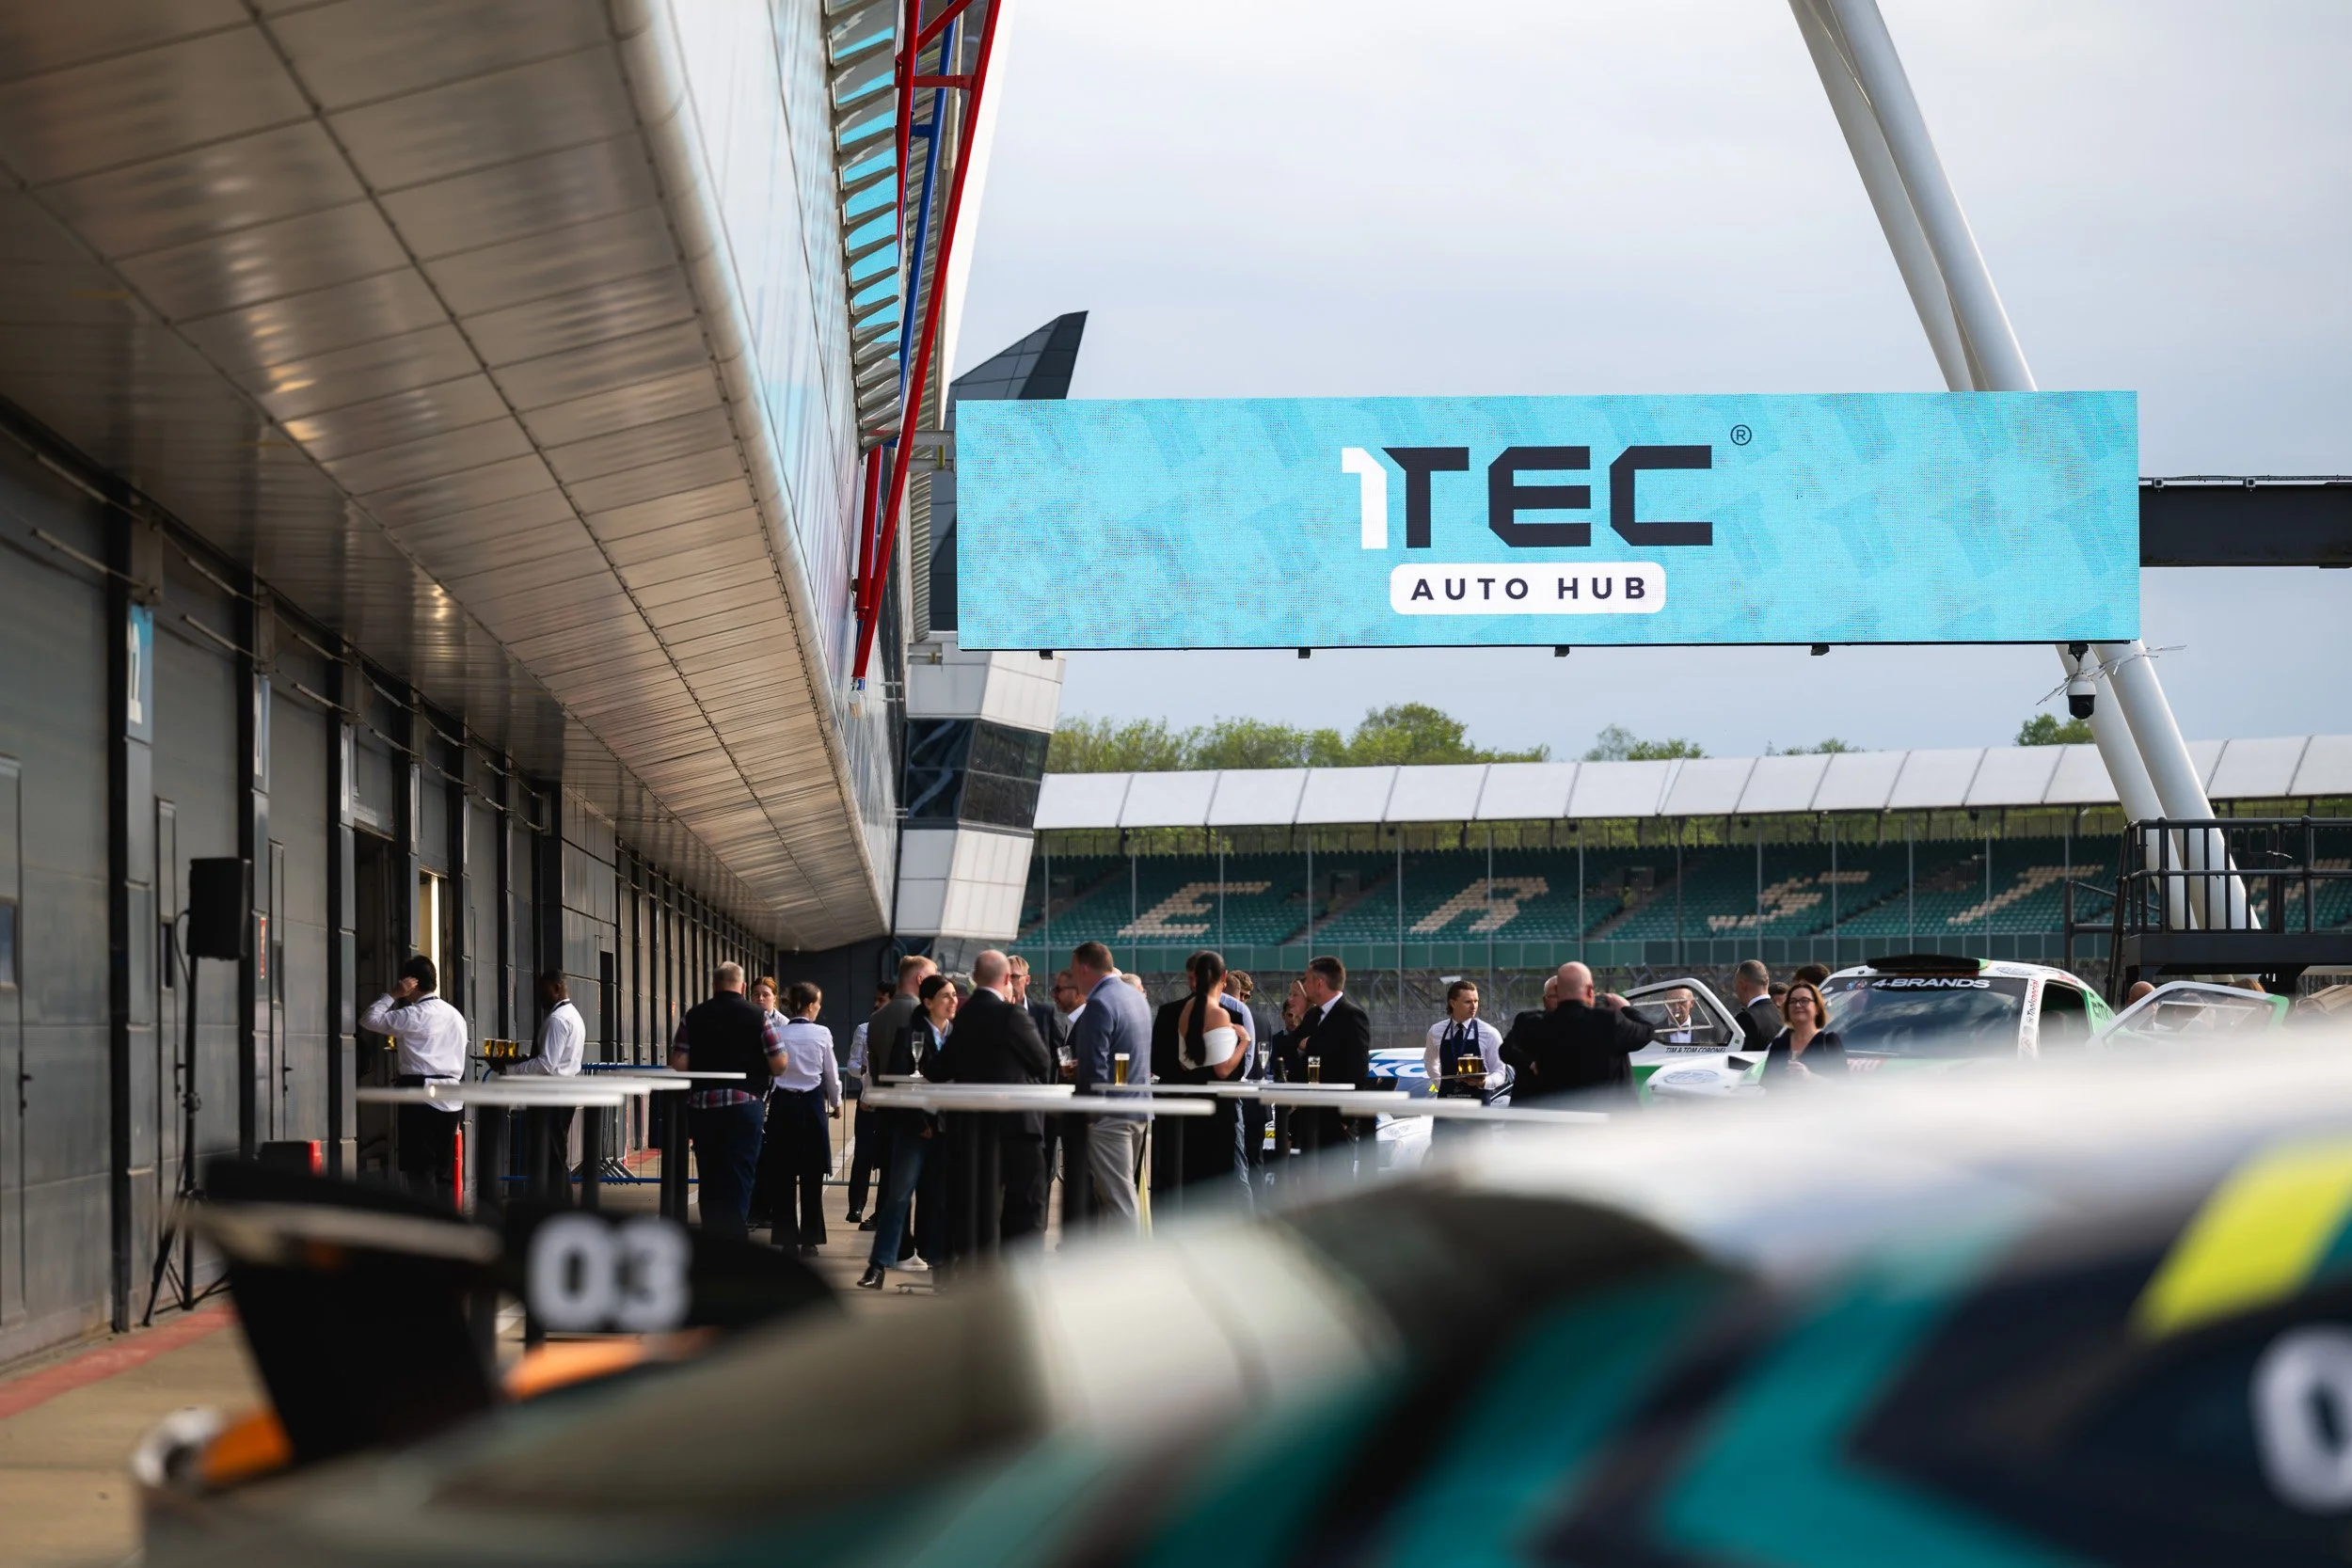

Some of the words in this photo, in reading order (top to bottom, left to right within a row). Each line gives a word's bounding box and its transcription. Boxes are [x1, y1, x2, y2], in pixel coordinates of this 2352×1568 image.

[1411, 578, 1530, 601] AUTO
[1557, 577, 1646, 600] HUB
[530, 1212, 692, 1332] 03
